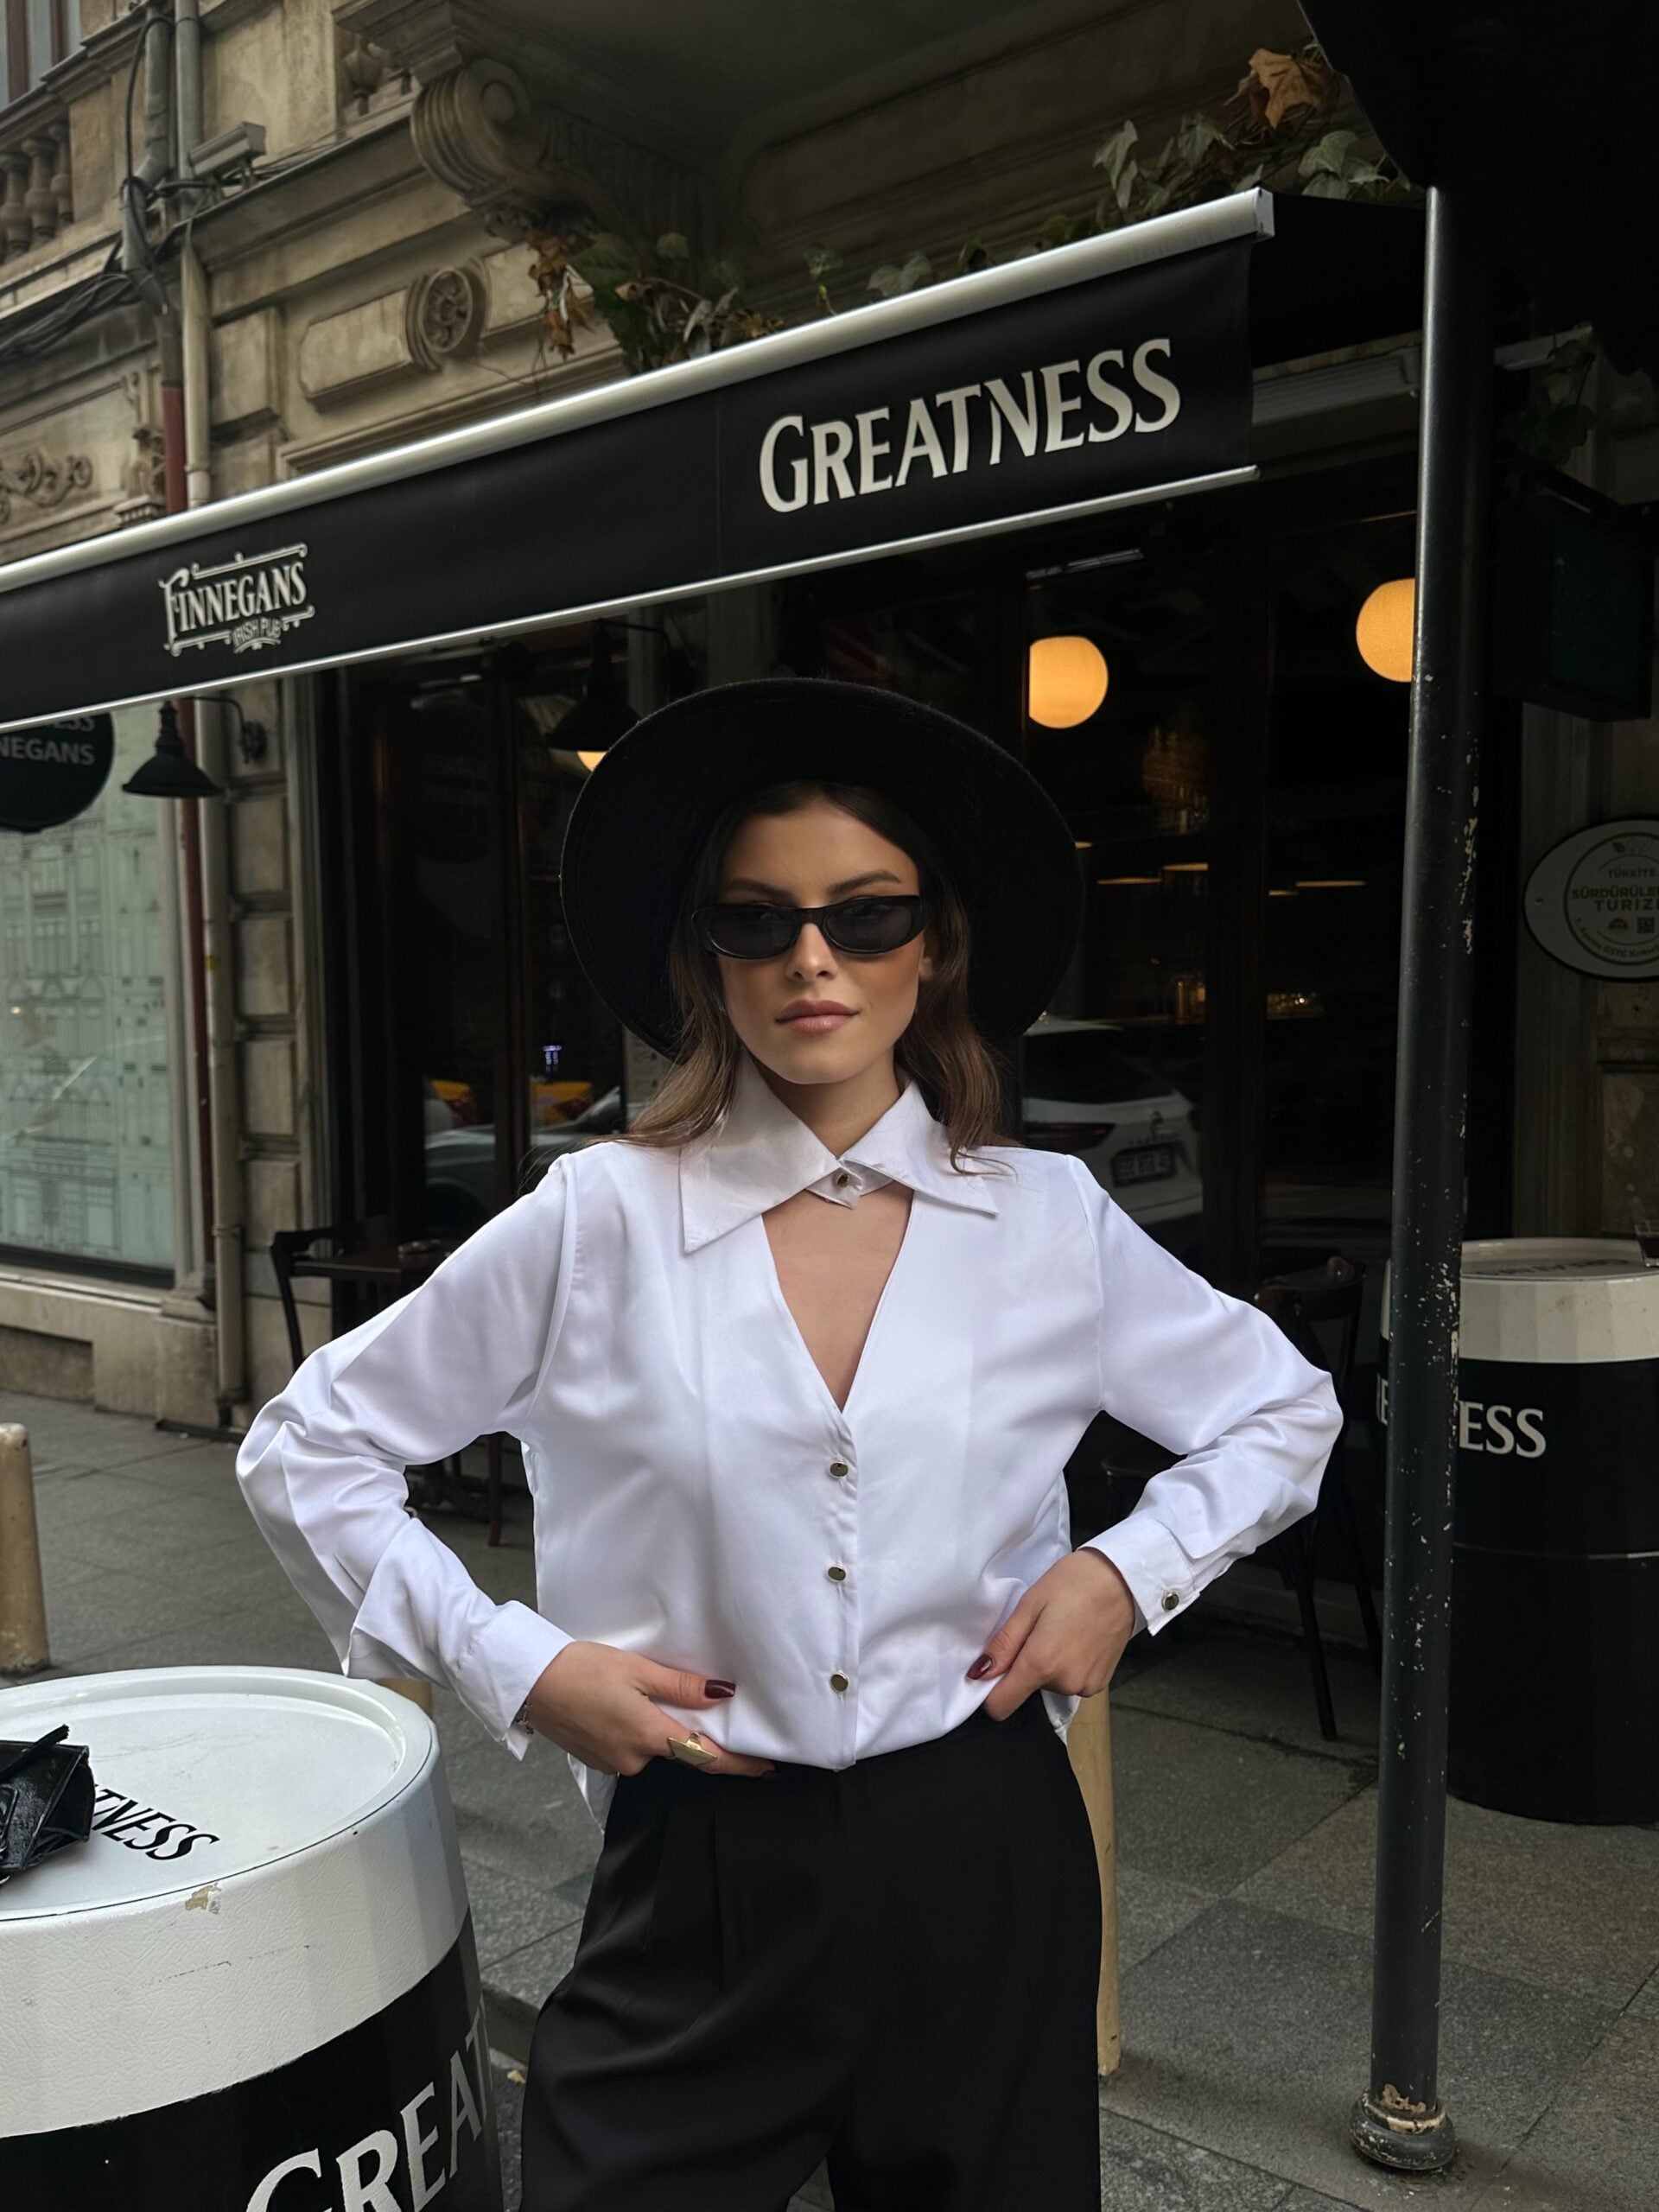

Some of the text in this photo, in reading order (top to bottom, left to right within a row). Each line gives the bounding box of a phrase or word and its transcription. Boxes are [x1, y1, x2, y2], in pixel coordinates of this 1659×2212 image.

[760, 338, 1182, 512] GREATNESS
[158, 562, 307, 645] FINNEGANS
[259, 616, 281, 638] PUB
[1572, 885, 1659, 899] SÜRDÜRÜLE
[1607, 867, 1656, 878] TÜRKİYE
[94, 1783, 220, 1860] TNESS
